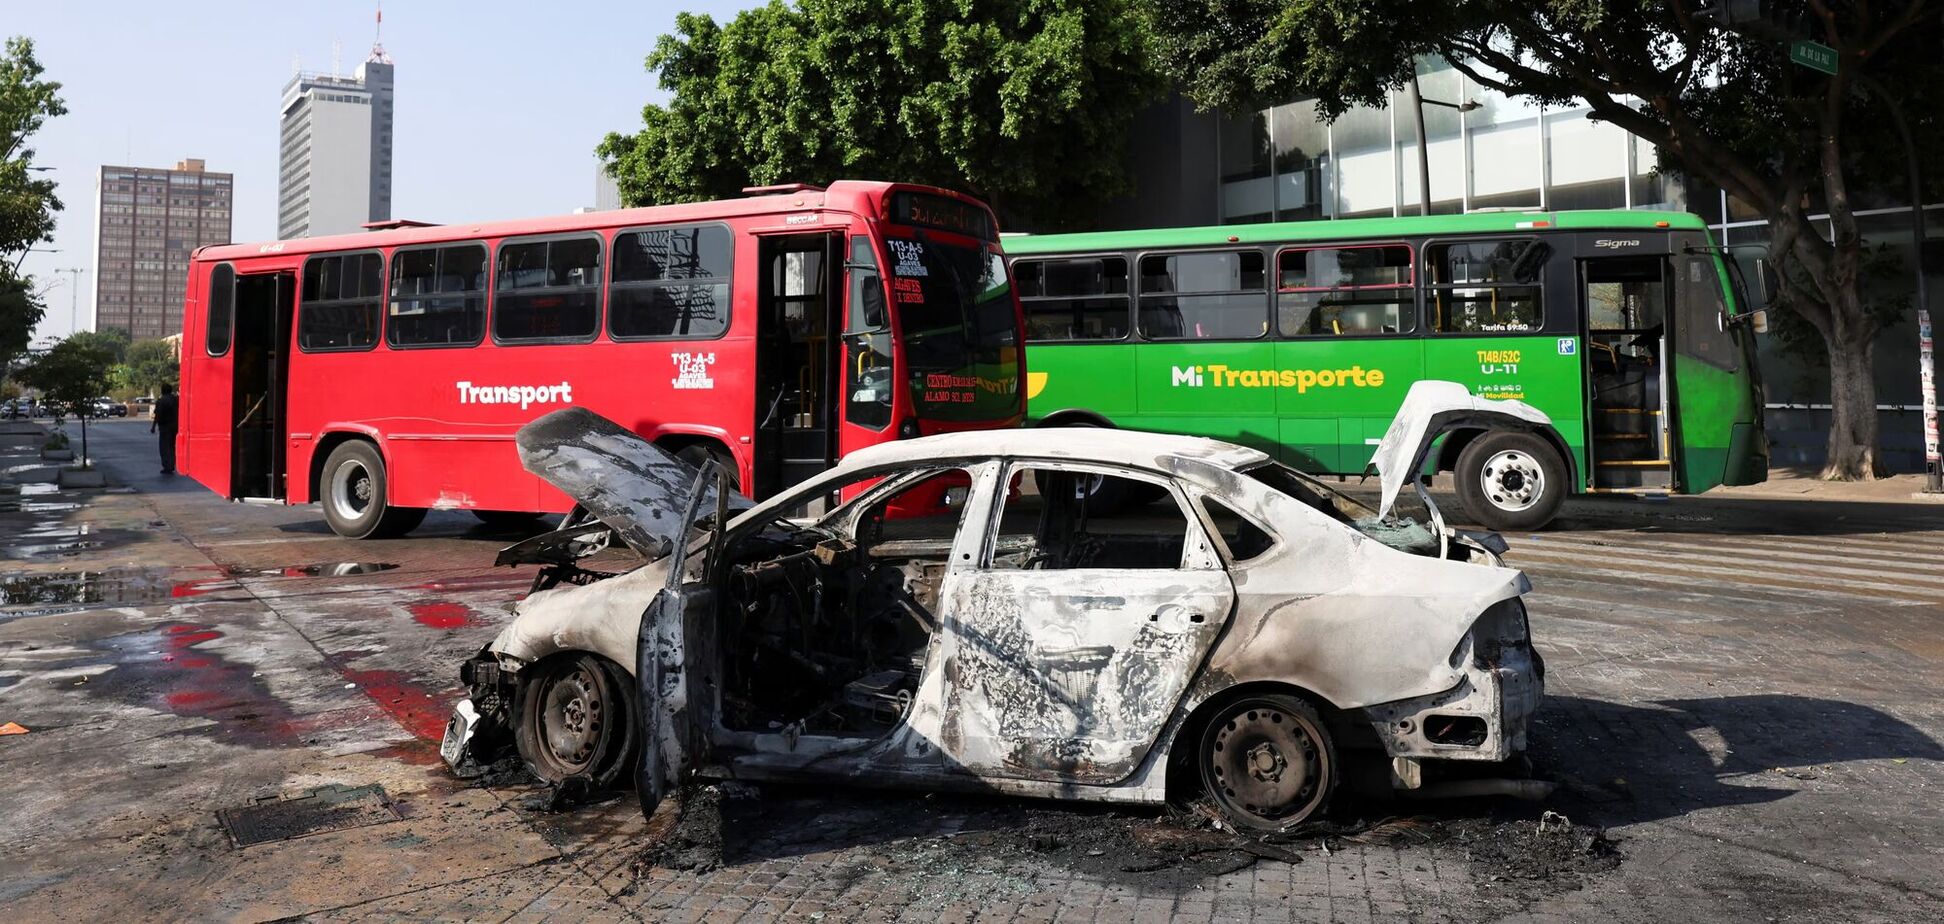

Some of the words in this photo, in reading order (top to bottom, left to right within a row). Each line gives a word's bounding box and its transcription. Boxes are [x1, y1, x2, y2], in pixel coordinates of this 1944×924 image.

[1594, 239, 1640, 249] Sigma
[897, 251, 919, 261] U-03
[671, 352, 716, 365] T13-A-5
[1477, 350, 1521, 364] T14B/52C
[679, 363, 706, 374] U-03
[1481, 364, 1518, 375] U-11
[1171, 365, 1204, 387] Mi
[1207, 364, 1385, 394] Transporte
[456, 381, 573, 410] Transport
